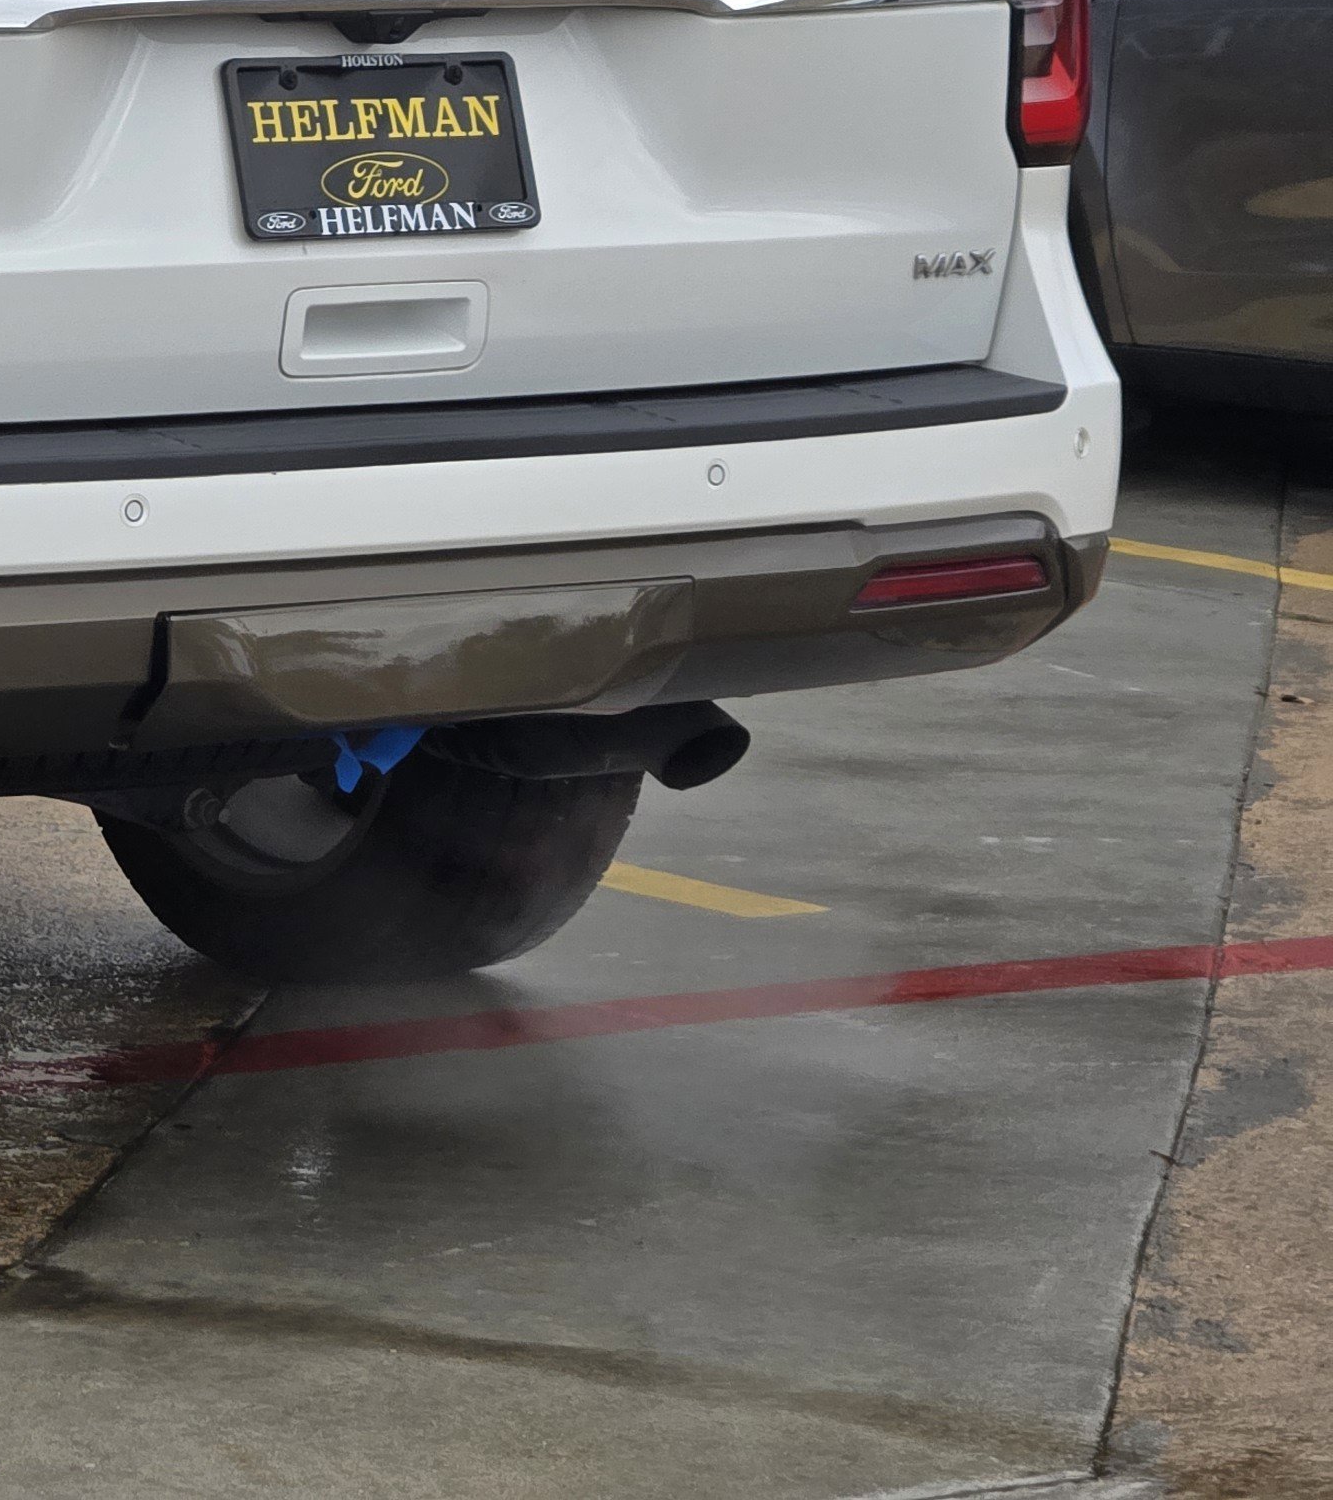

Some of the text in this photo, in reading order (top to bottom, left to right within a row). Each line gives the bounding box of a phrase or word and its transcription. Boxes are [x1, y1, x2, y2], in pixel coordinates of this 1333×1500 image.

[341, 54, 404, 68] HOUSTON
[247, 95, 500, 143] HELFMAN
[348, 159, 424, 199] Ford
[317, 201, 478, 236] HELFMAN
[913, 248, 996, 280] MAX
